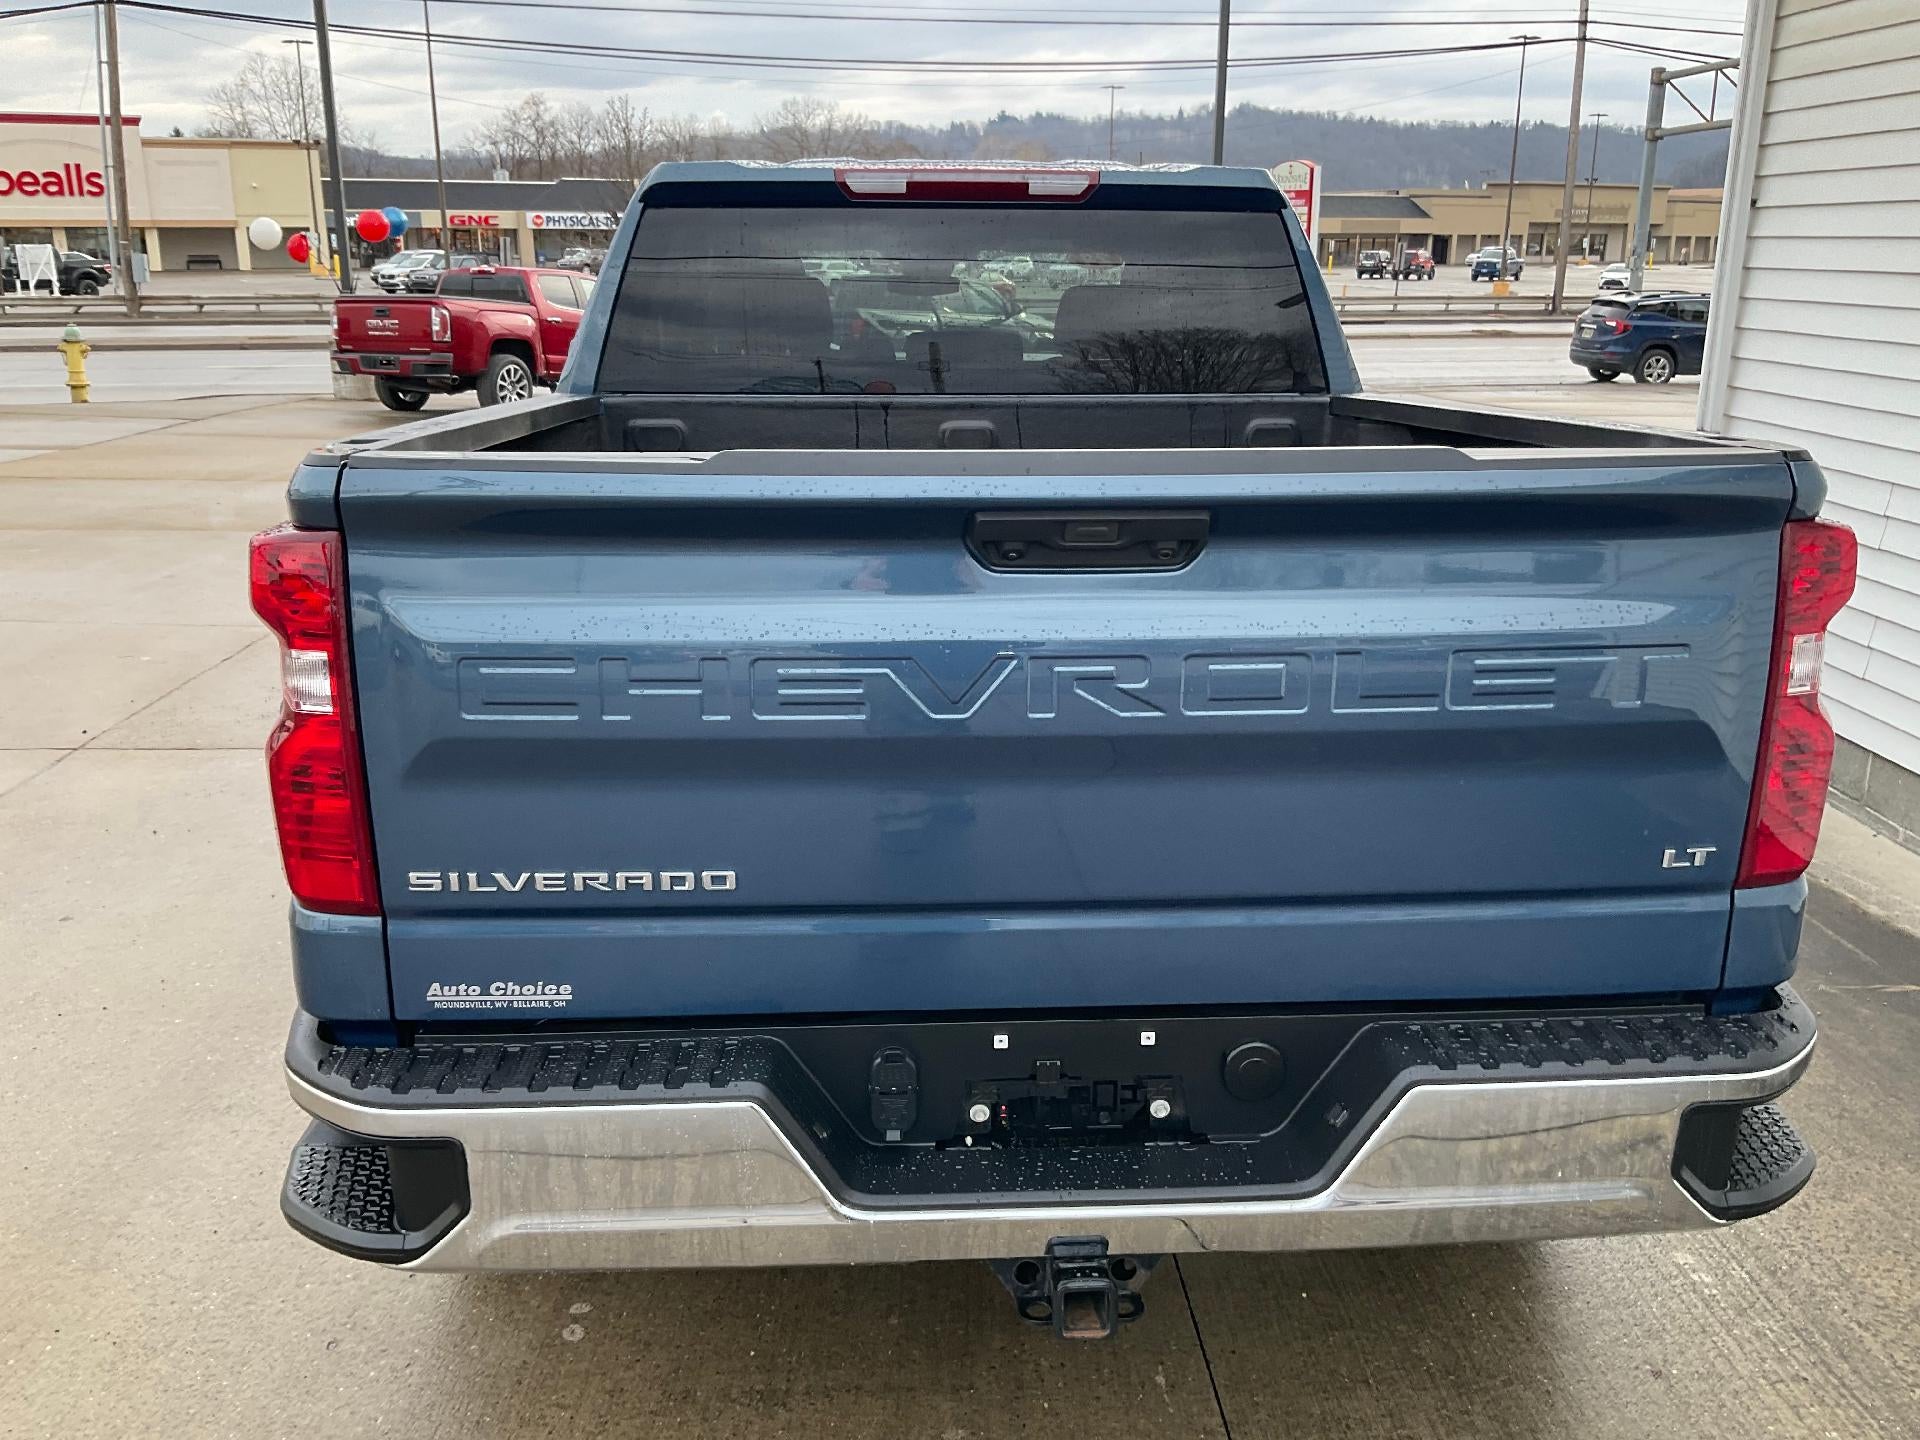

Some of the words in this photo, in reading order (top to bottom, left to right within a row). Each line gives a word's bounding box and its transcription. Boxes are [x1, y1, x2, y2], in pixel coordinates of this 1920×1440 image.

[449, 215, 500, 226] GNC
[545, 215, 600, 228] PHYSICAL
[366, 319, 399, 328] GMC
[456, 643, 1690, 722] CHEVROLET
[1661, 846, 1717, 868] LT
[407, 870, 738, 893] SILVERADO
[426, 982, 481, 996] Auto
[489, 981, 573, 996] Choice
[434, 1000, 493, 1010] MOUNDSVILLE,
[513, 1000, 552, 1009] BELLAIRE,
[553, 1000, 566, 1008] OH
